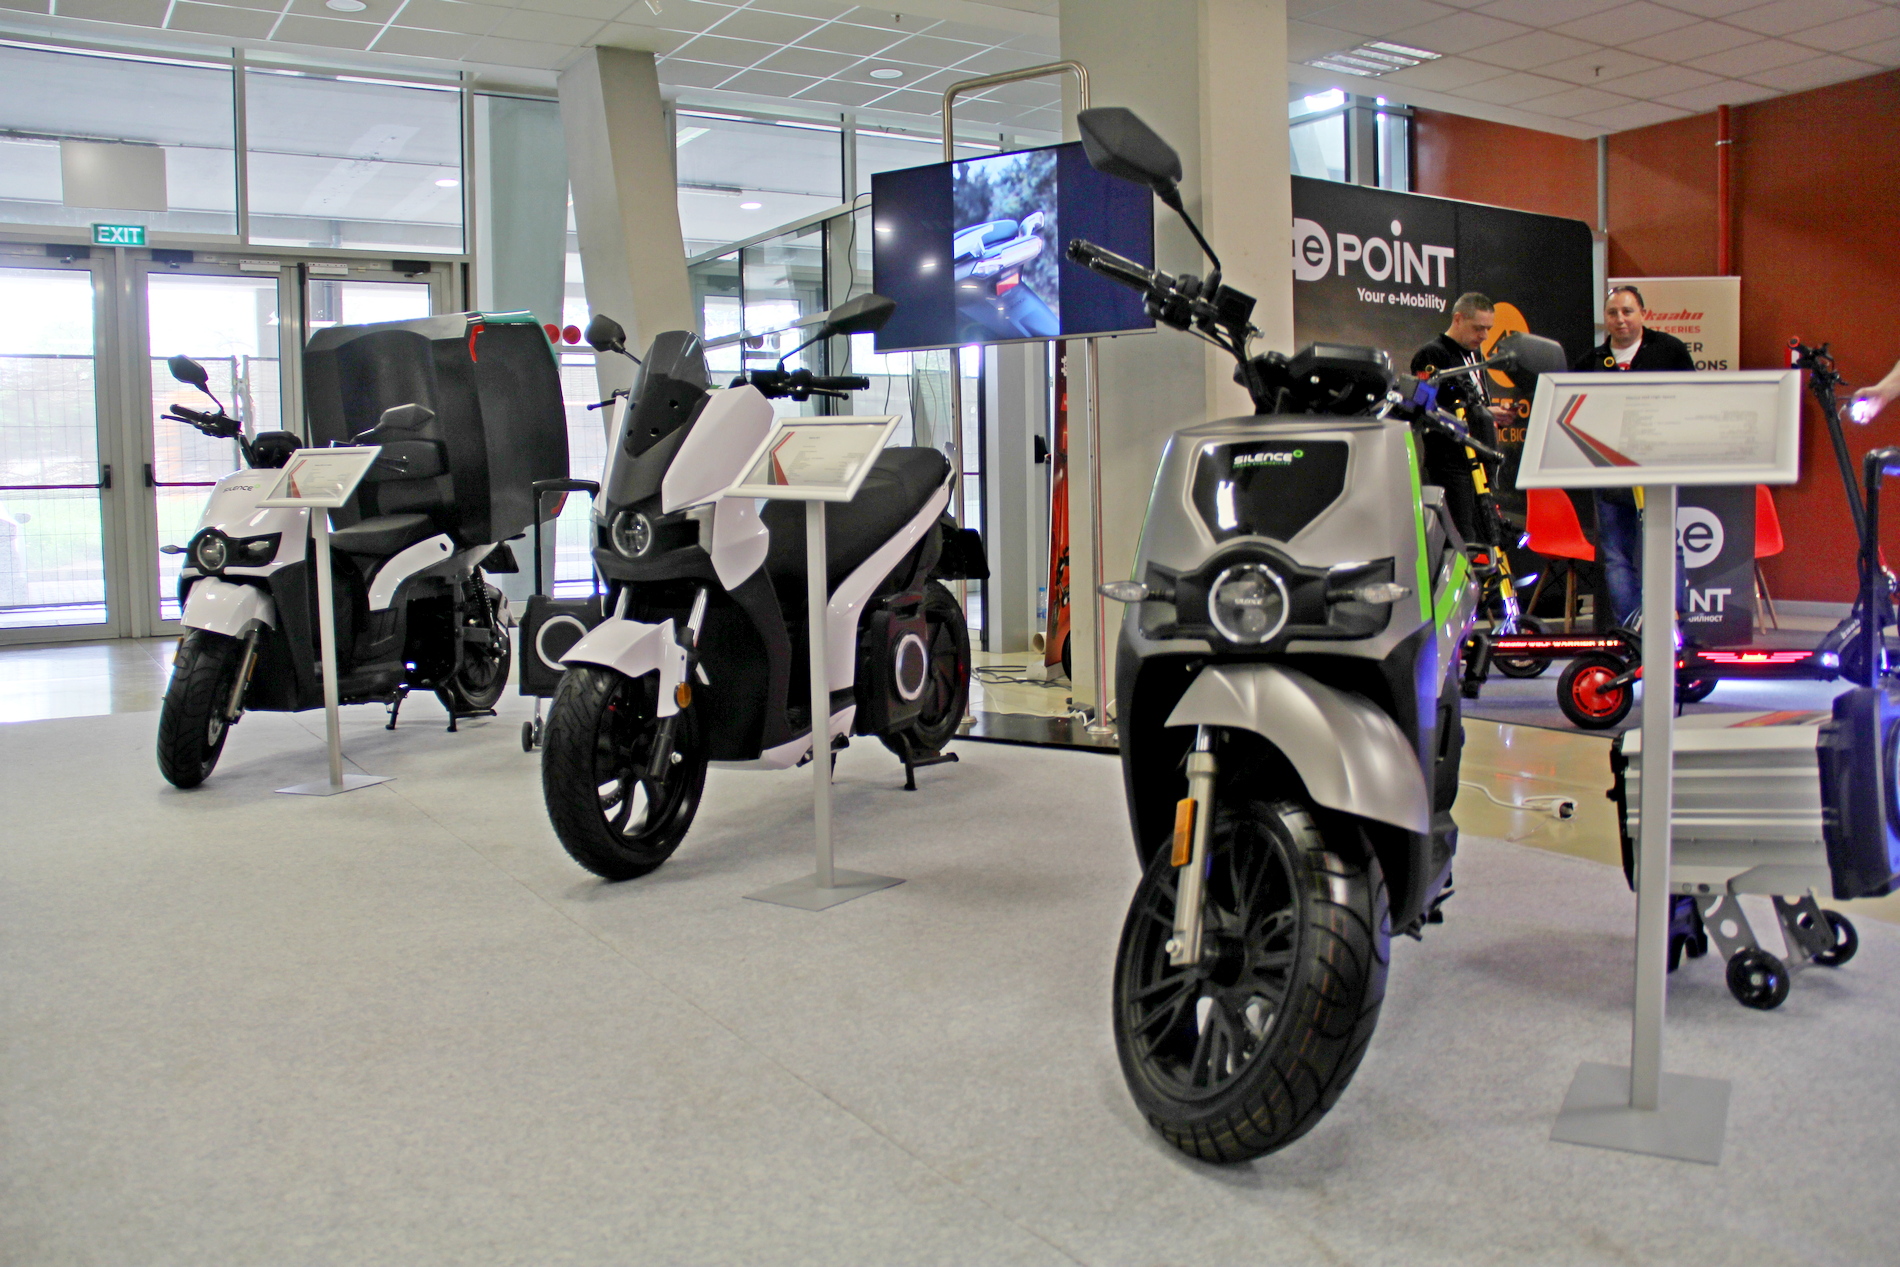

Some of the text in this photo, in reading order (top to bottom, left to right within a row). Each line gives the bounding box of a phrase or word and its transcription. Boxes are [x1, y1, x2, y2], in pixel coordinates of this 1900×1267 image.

[97, 226, 141, 243] EXIT
[1357, 287, 1447, 313] Your e-Mobility
[1664, 325, 1701, 334] SERIES
[1233, 452, 1293, 465] SILENCE
[1689, 587, 1732, 613] NT
